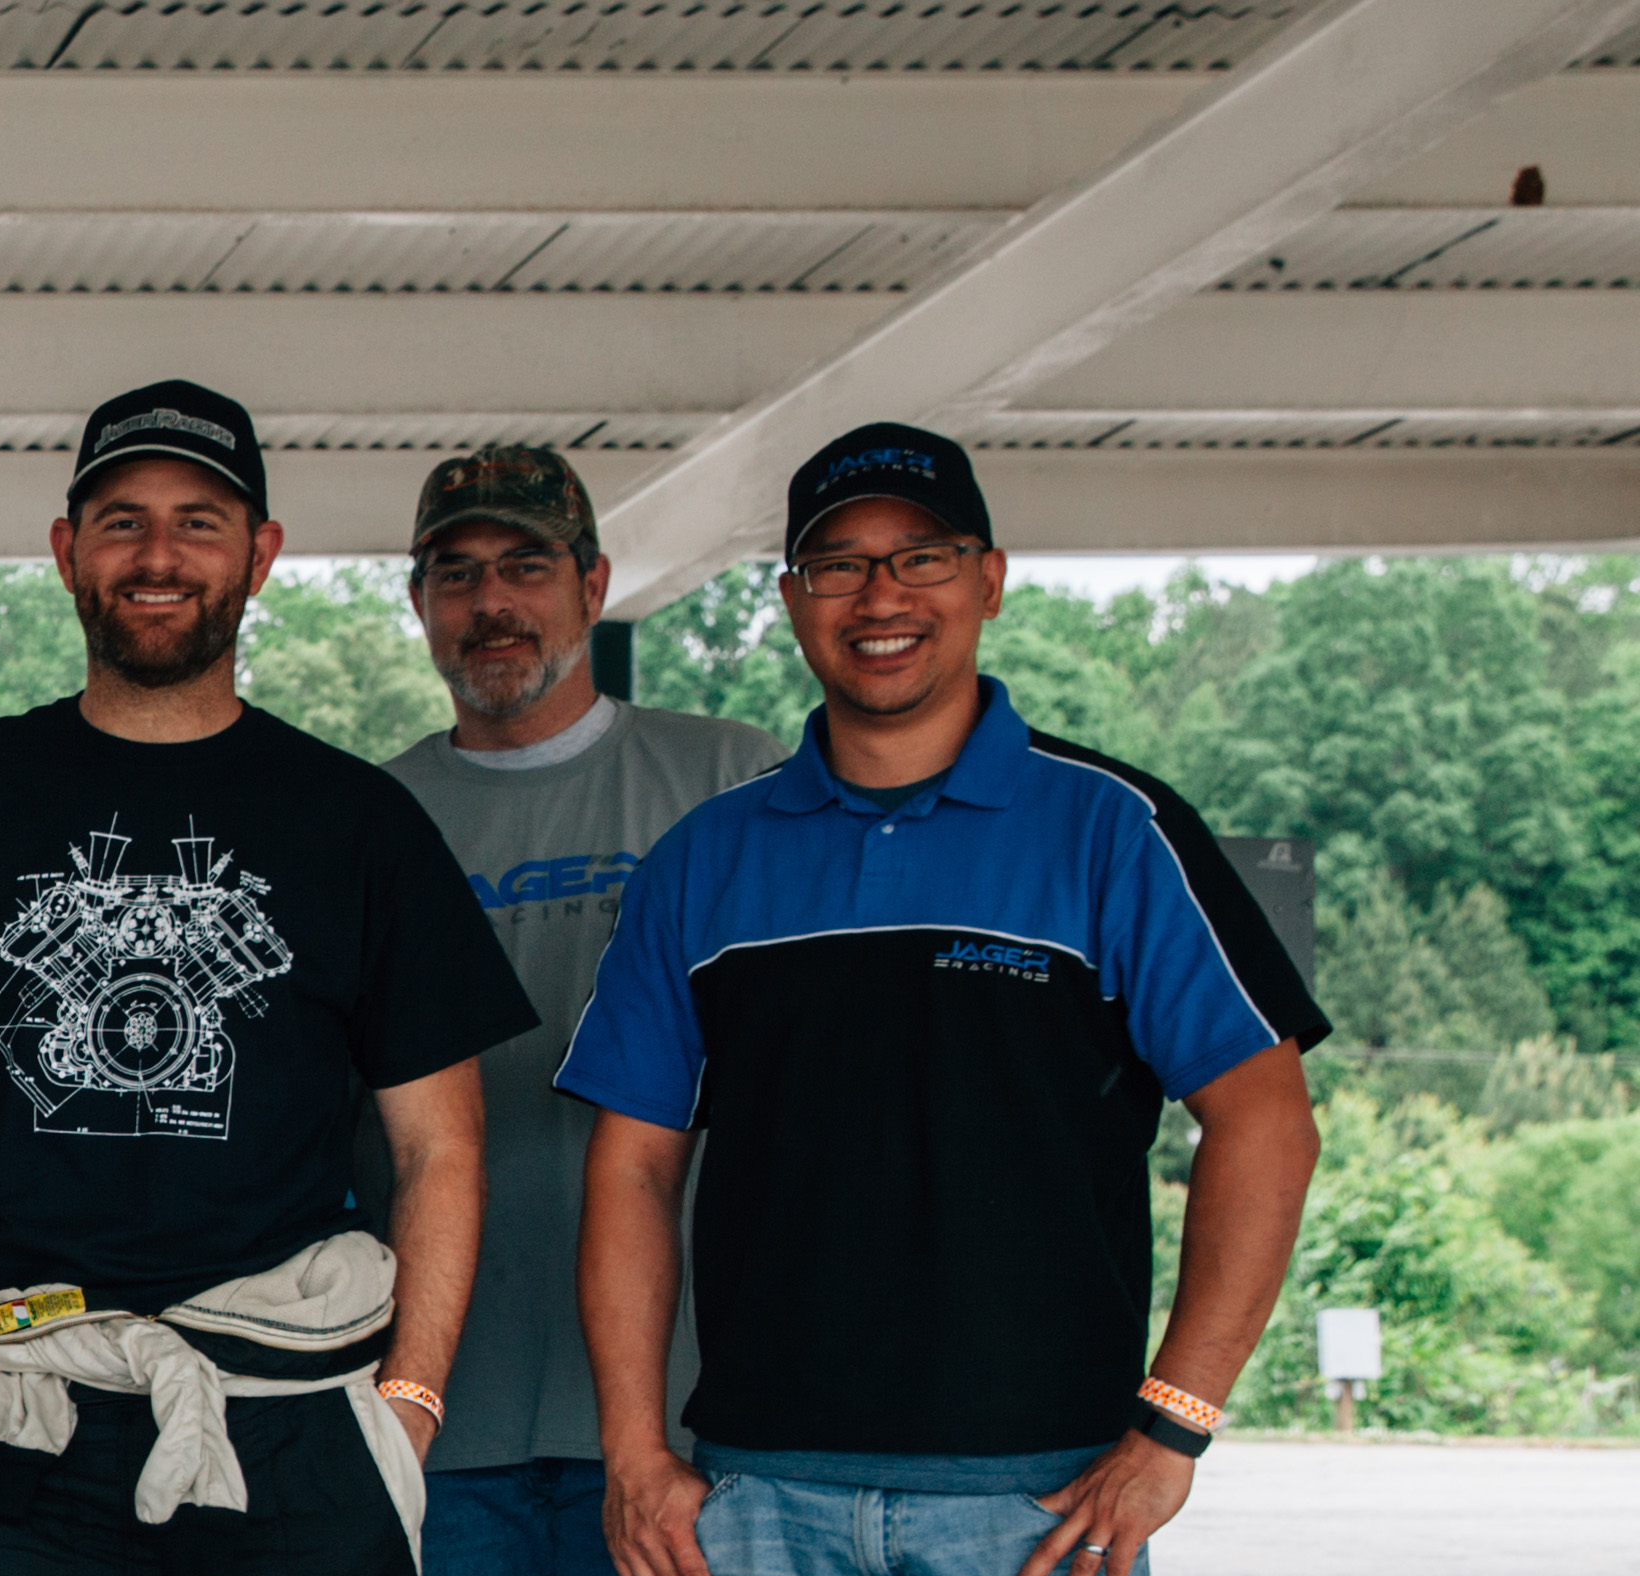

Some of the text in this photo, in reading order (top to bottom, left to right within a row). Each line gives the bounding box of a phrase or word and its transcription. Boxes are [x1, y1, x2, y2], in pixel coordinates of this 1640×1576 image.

[469, 851, 639, 909] AGER
[935, 940, 1050, 973] JAGER
[951, 960, 1033, 981] RACING
